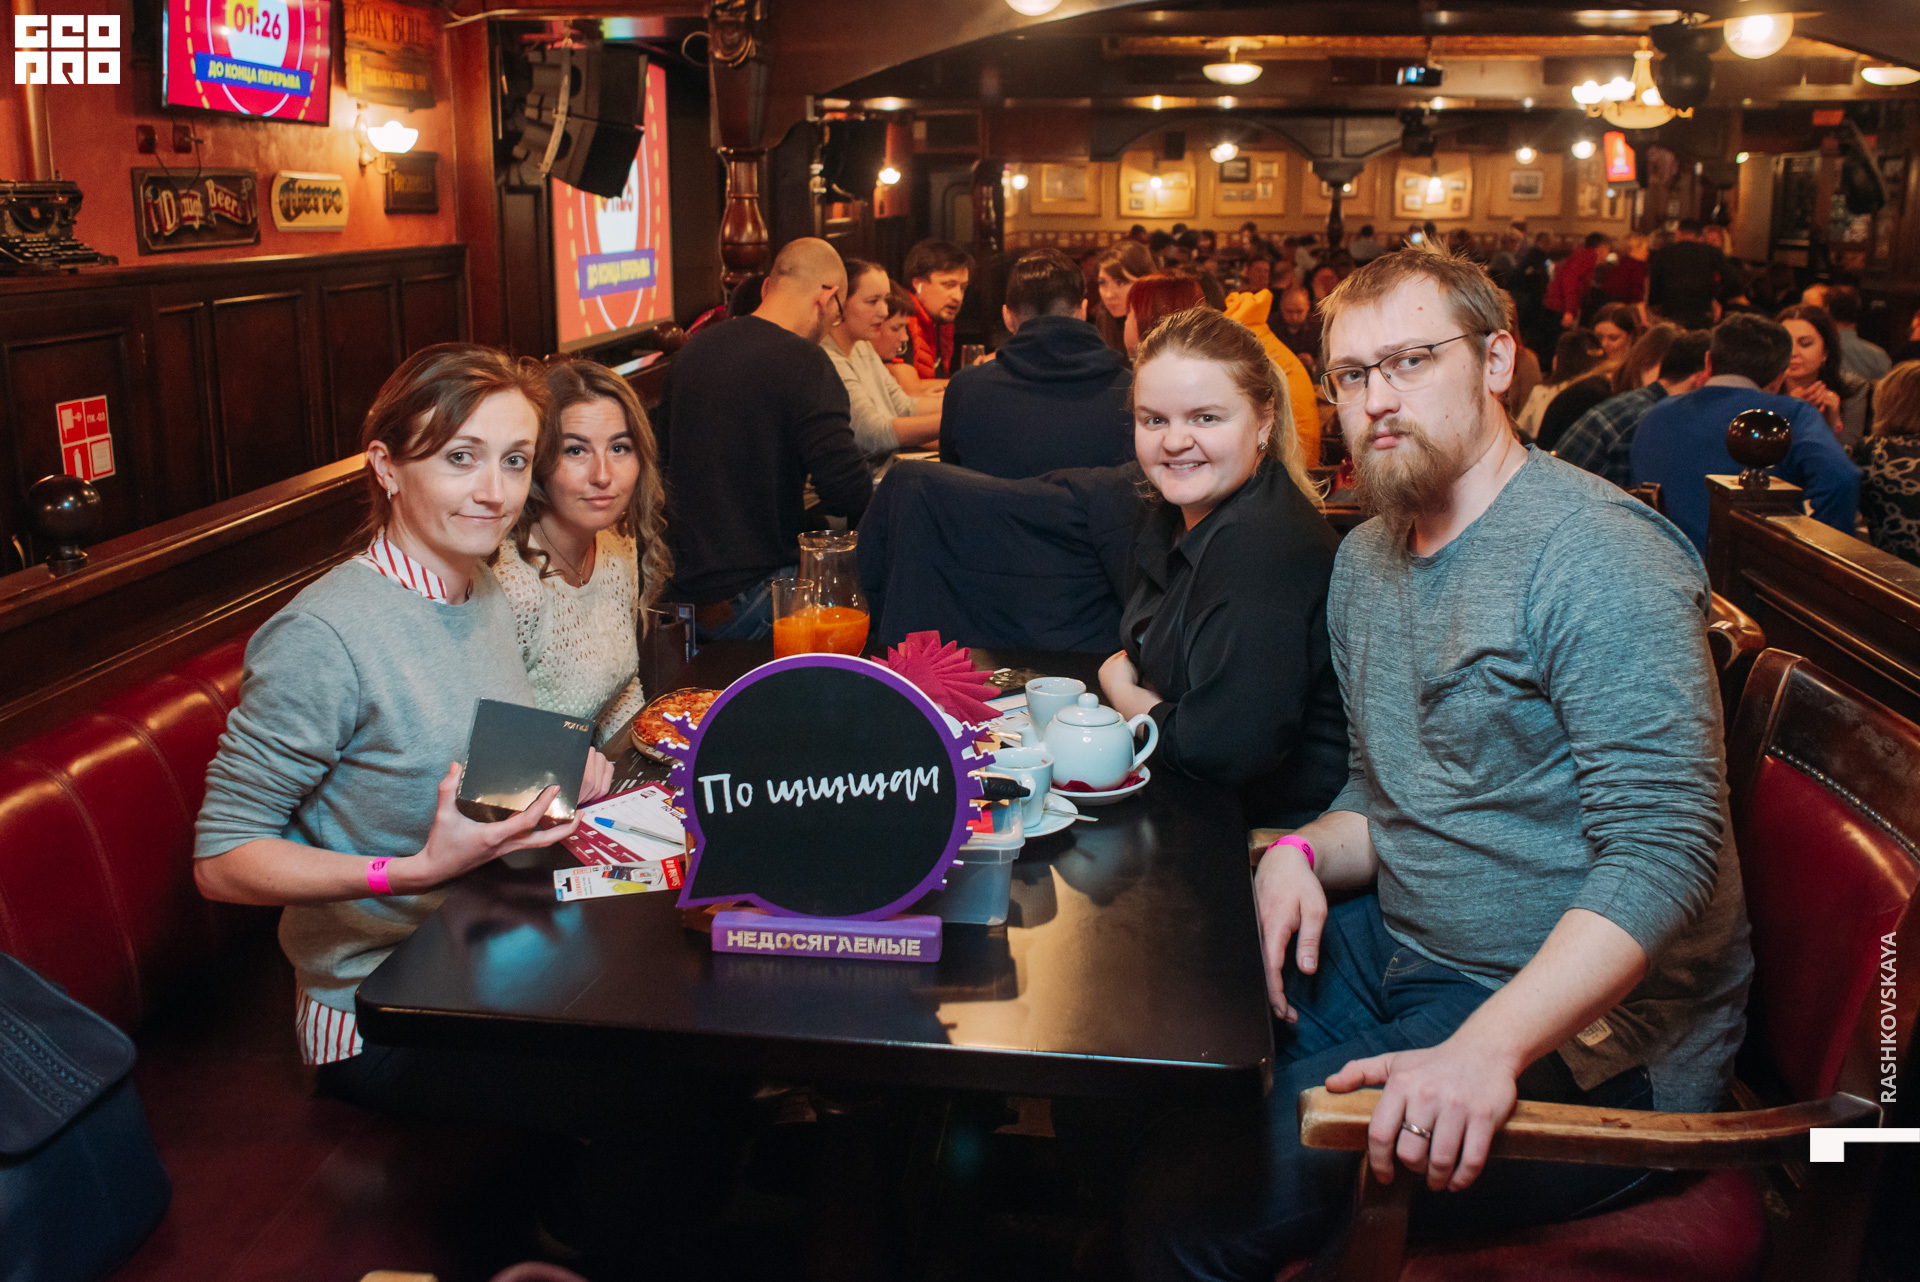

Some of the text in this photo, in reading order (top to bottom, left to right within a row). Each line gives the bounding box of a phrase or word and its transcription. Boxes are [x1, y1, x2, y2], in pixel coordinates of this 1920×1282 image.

[234, 3, 281, 40] 01:26
[346, 2, 424, 48] JOHN BULL
[207, 60, 301, 90] ДО КОНЦА ПЕРЕРЫВА
[698, 773, 753, 814] По
[727, 930, 921, 957] НЕДОСЯГАЕМЫЕ
